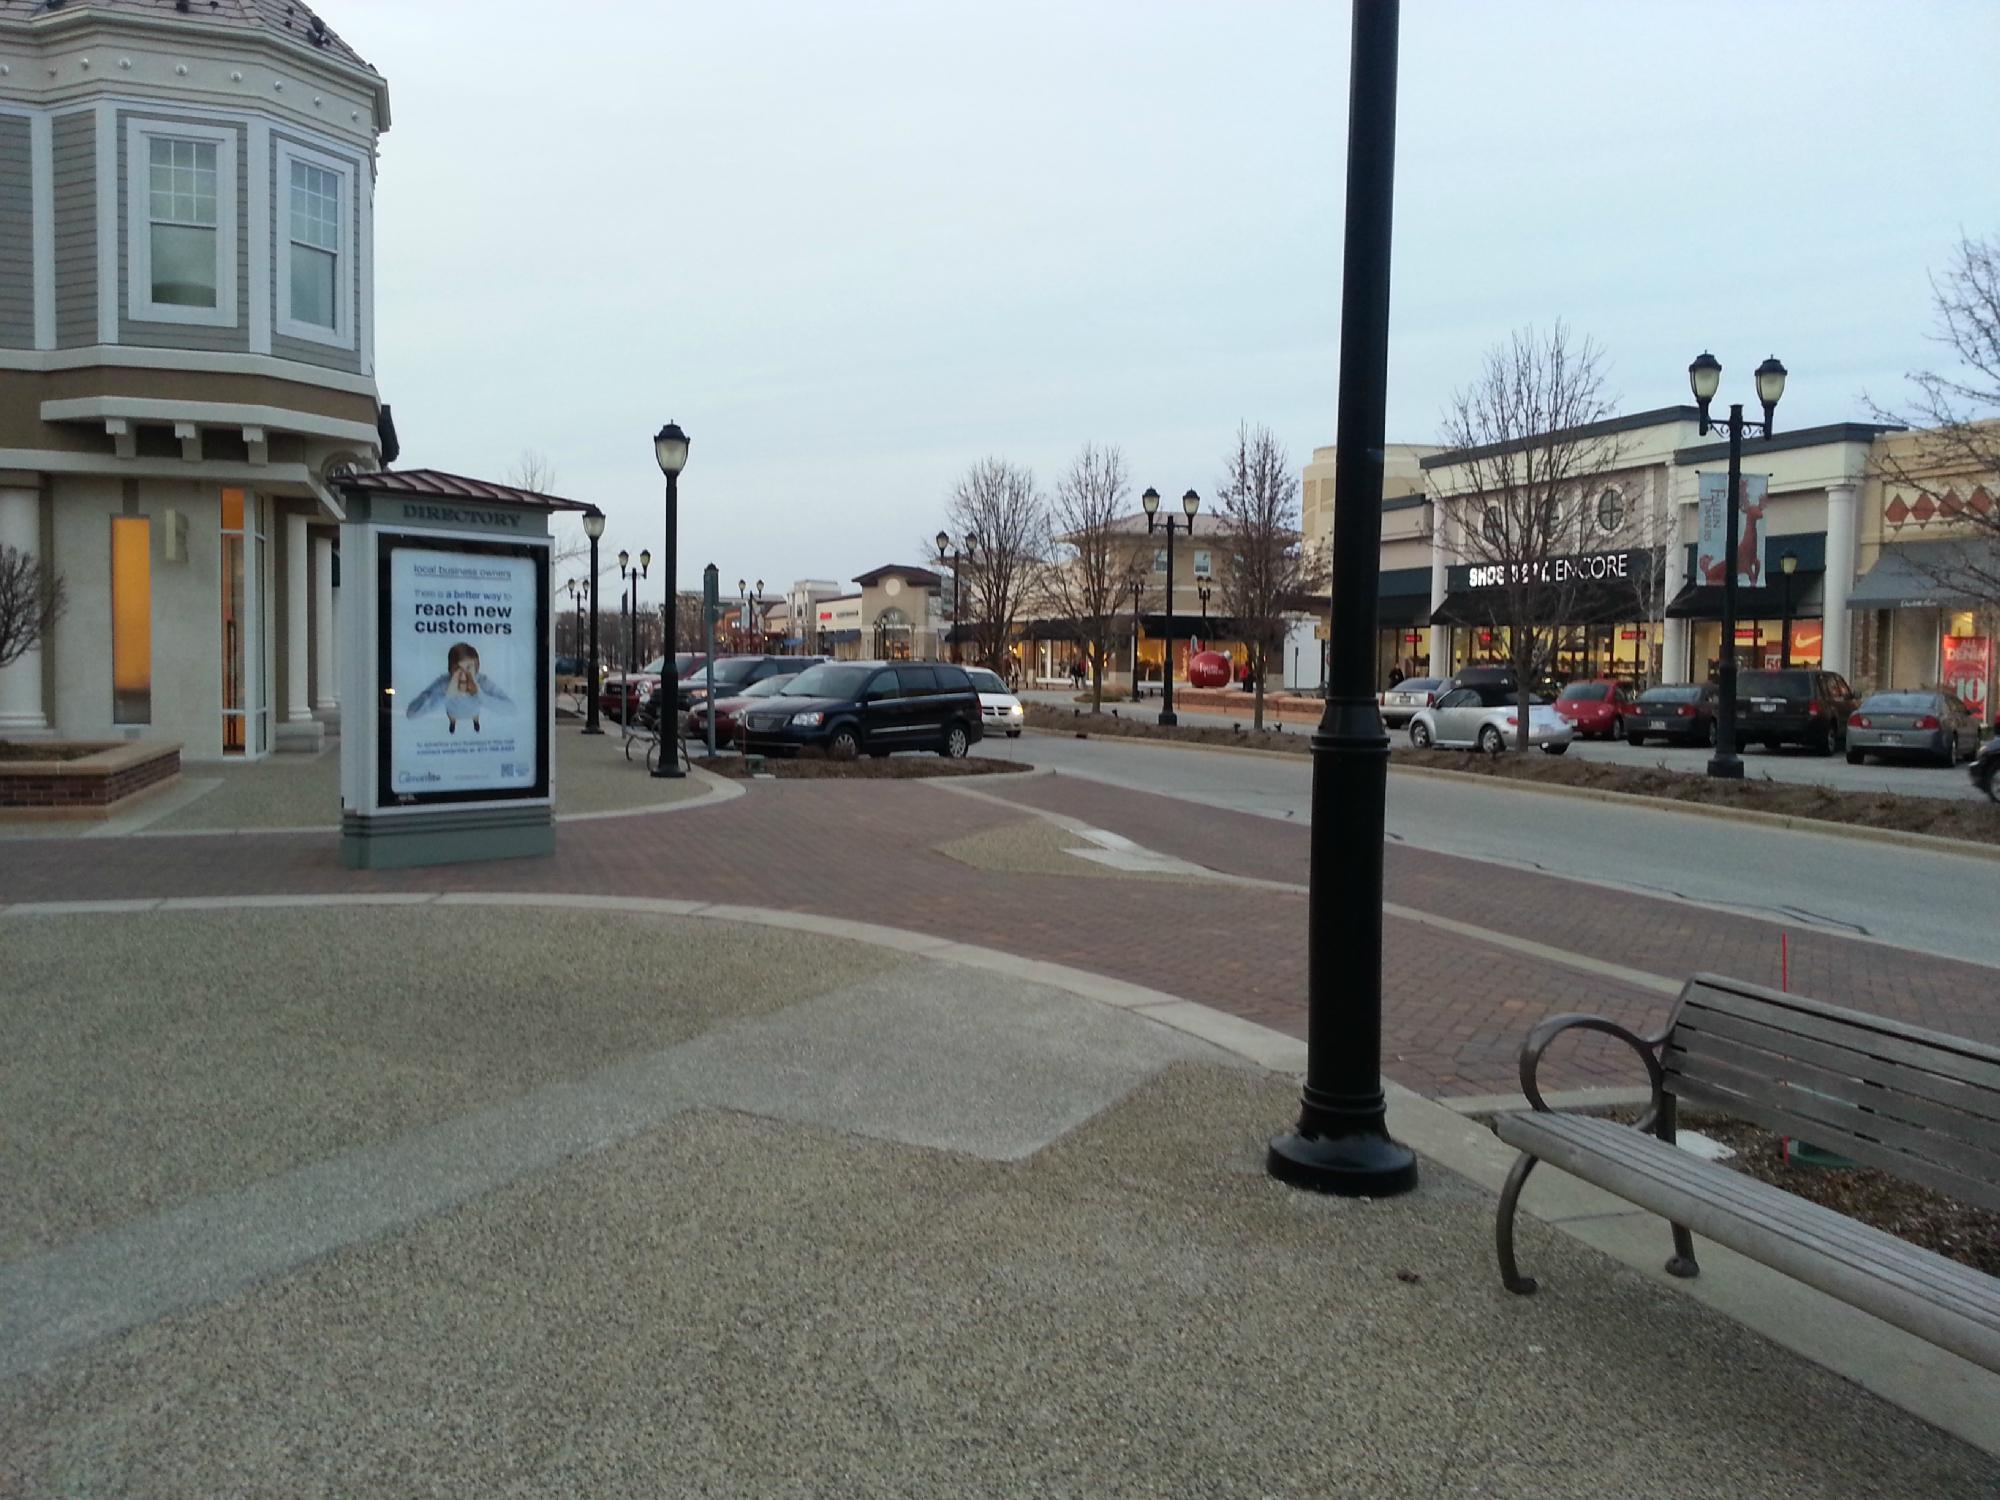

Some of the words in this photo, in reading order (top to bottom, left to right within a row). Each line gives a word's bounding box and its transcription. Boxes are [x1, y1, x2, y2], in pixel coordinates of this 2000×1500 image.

[403, 503, 521, 527] DIRECTORY
[1469, 565, 1505, 588] SHOE
[1555, 553, 1628, 582] ENCORE
[454, 590, 480, 600] better
[483, 591, 502, 602] way
[415, 601, 468, 618] reach
[474, 604, 512, 619] new
[414, 619, 512, 636] customers
